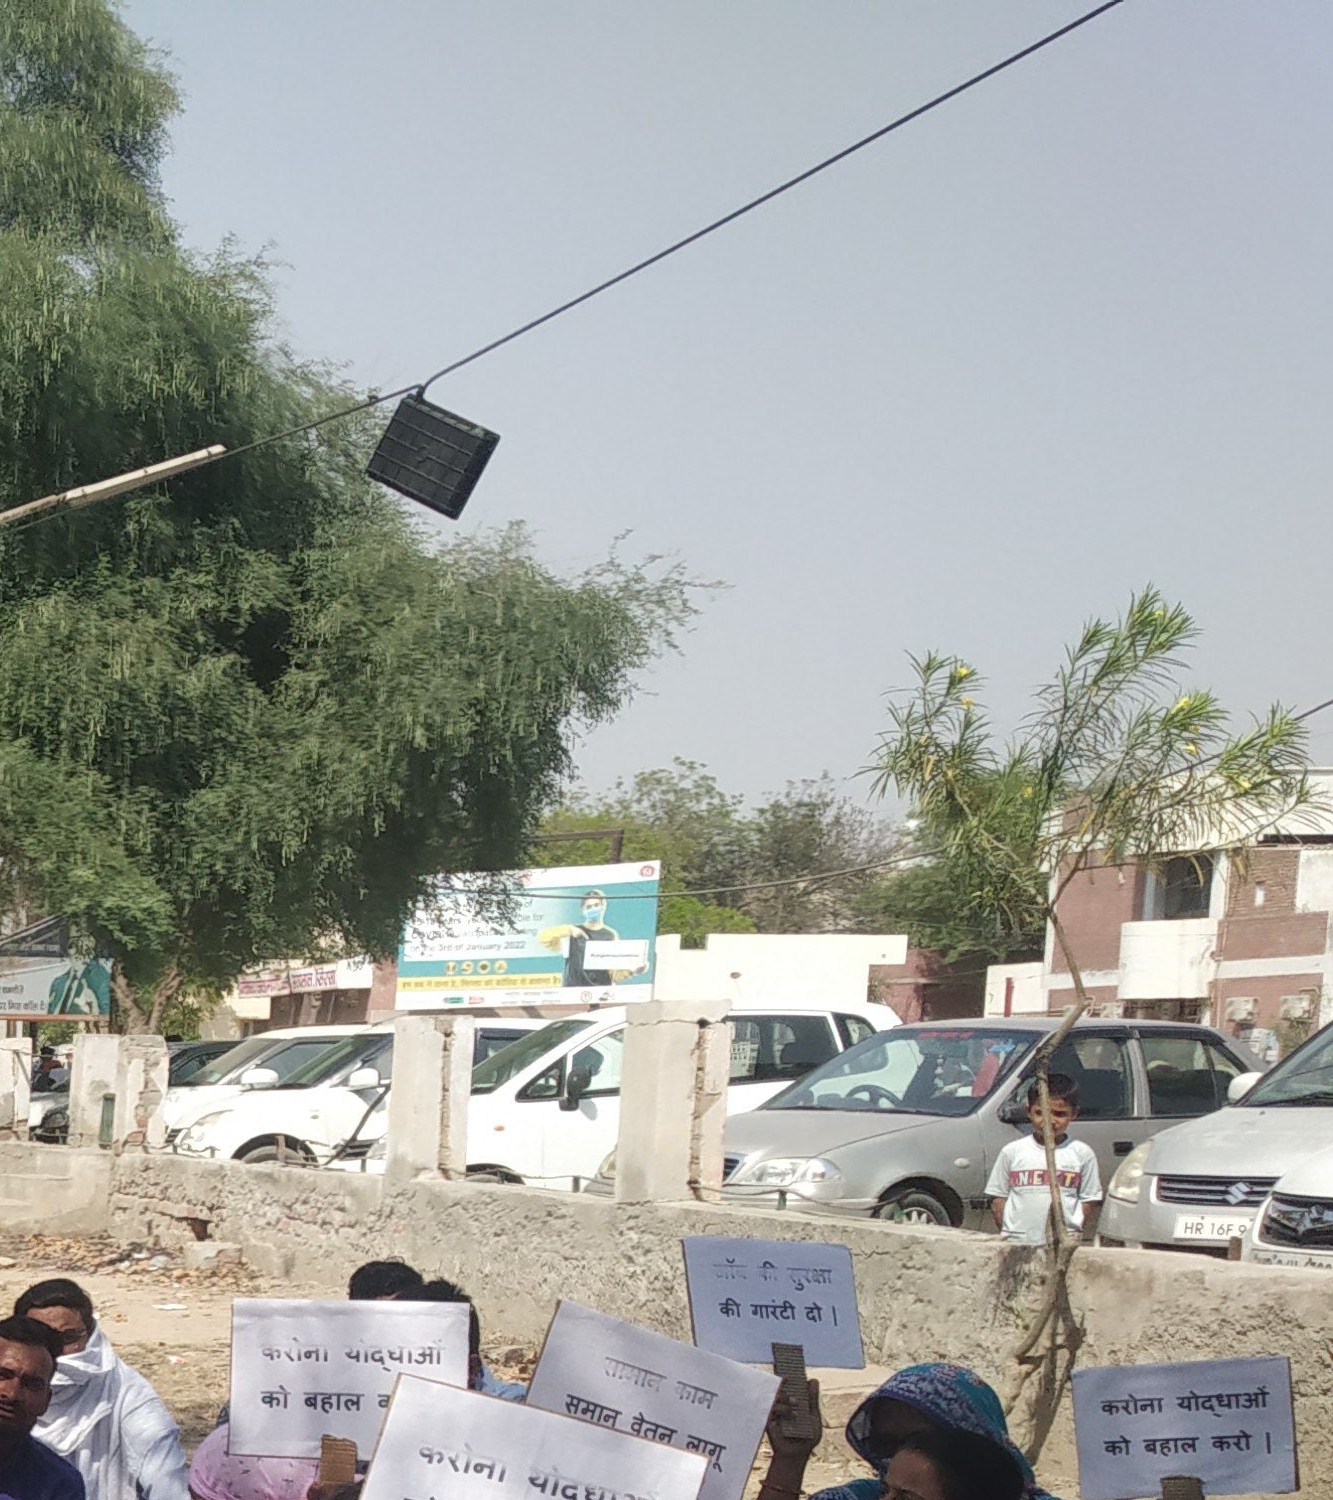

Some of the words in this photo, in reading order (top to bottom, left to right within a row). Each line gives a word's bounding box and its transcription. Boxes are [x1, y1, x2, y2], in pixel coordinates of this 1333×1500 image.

[466, 942, 502, 953] January
[503, 940, 526, 950] 2022
[1184, 1222, 1204, 1235] HR
[1210, 1222, 1233, 1236] 16F
[718, 1298, 742, 1318] की
[750, 1299, 796, 1321] गारंटी
[804, 1302, 823, 1323] दो
[260, 1337, 329, 1363] करोना
[261, 1385, 291, 1409] को
[303, 1391, 365, 1414] बहाल
[675, 1381, 719, 1410] काम
[1101, 1393, 1164, 1415] करोना
[565, 1393, 623, 1428] समान
[631, 1412, 678, 1444] वेतन
[686, 1434, 727, 1473] लागू
[1103, 1435, 1131, 1456] को
[1143, 1436, 1199, 1457] बहाल
[1211, 1429, 1253, 1452] करो
[419, 1442, 507, 1483] करोना
